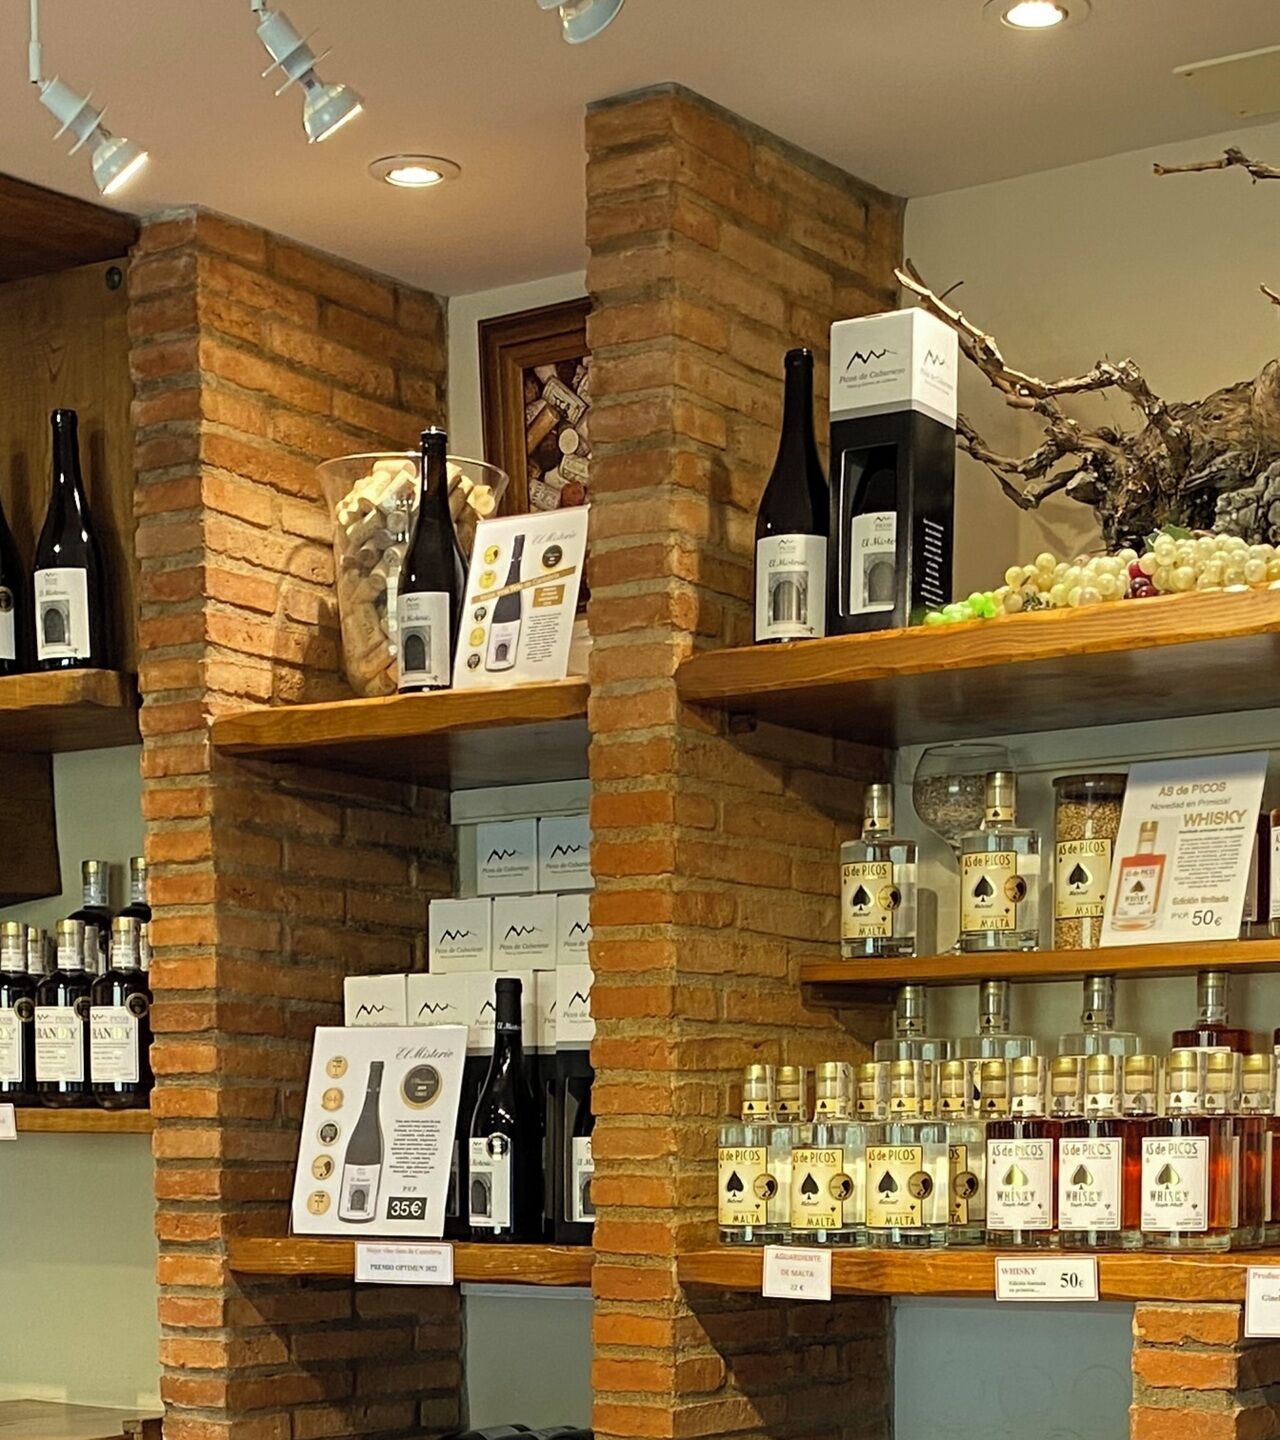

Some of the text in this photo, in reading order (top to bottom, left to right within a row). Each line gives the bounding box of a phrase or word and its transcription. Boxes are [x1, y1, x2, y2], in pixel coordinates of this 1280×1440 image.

[1158, 782, 1227, 797] AS de PICOS
[1151, 800, 1184, 810] Novedad
[1183, 809, 1248, 827] WHISKY
[980, 919, 1010, 928] MALTA
[391, 1200, 422, 1216] 35€
[732, 1215, 761, 1224] MALTA
[807, 1217, 836, 1227] MALTA
[884, 1215, 915, 1226] MALTA
[1060, 1272, 1084, 1288] 50€
